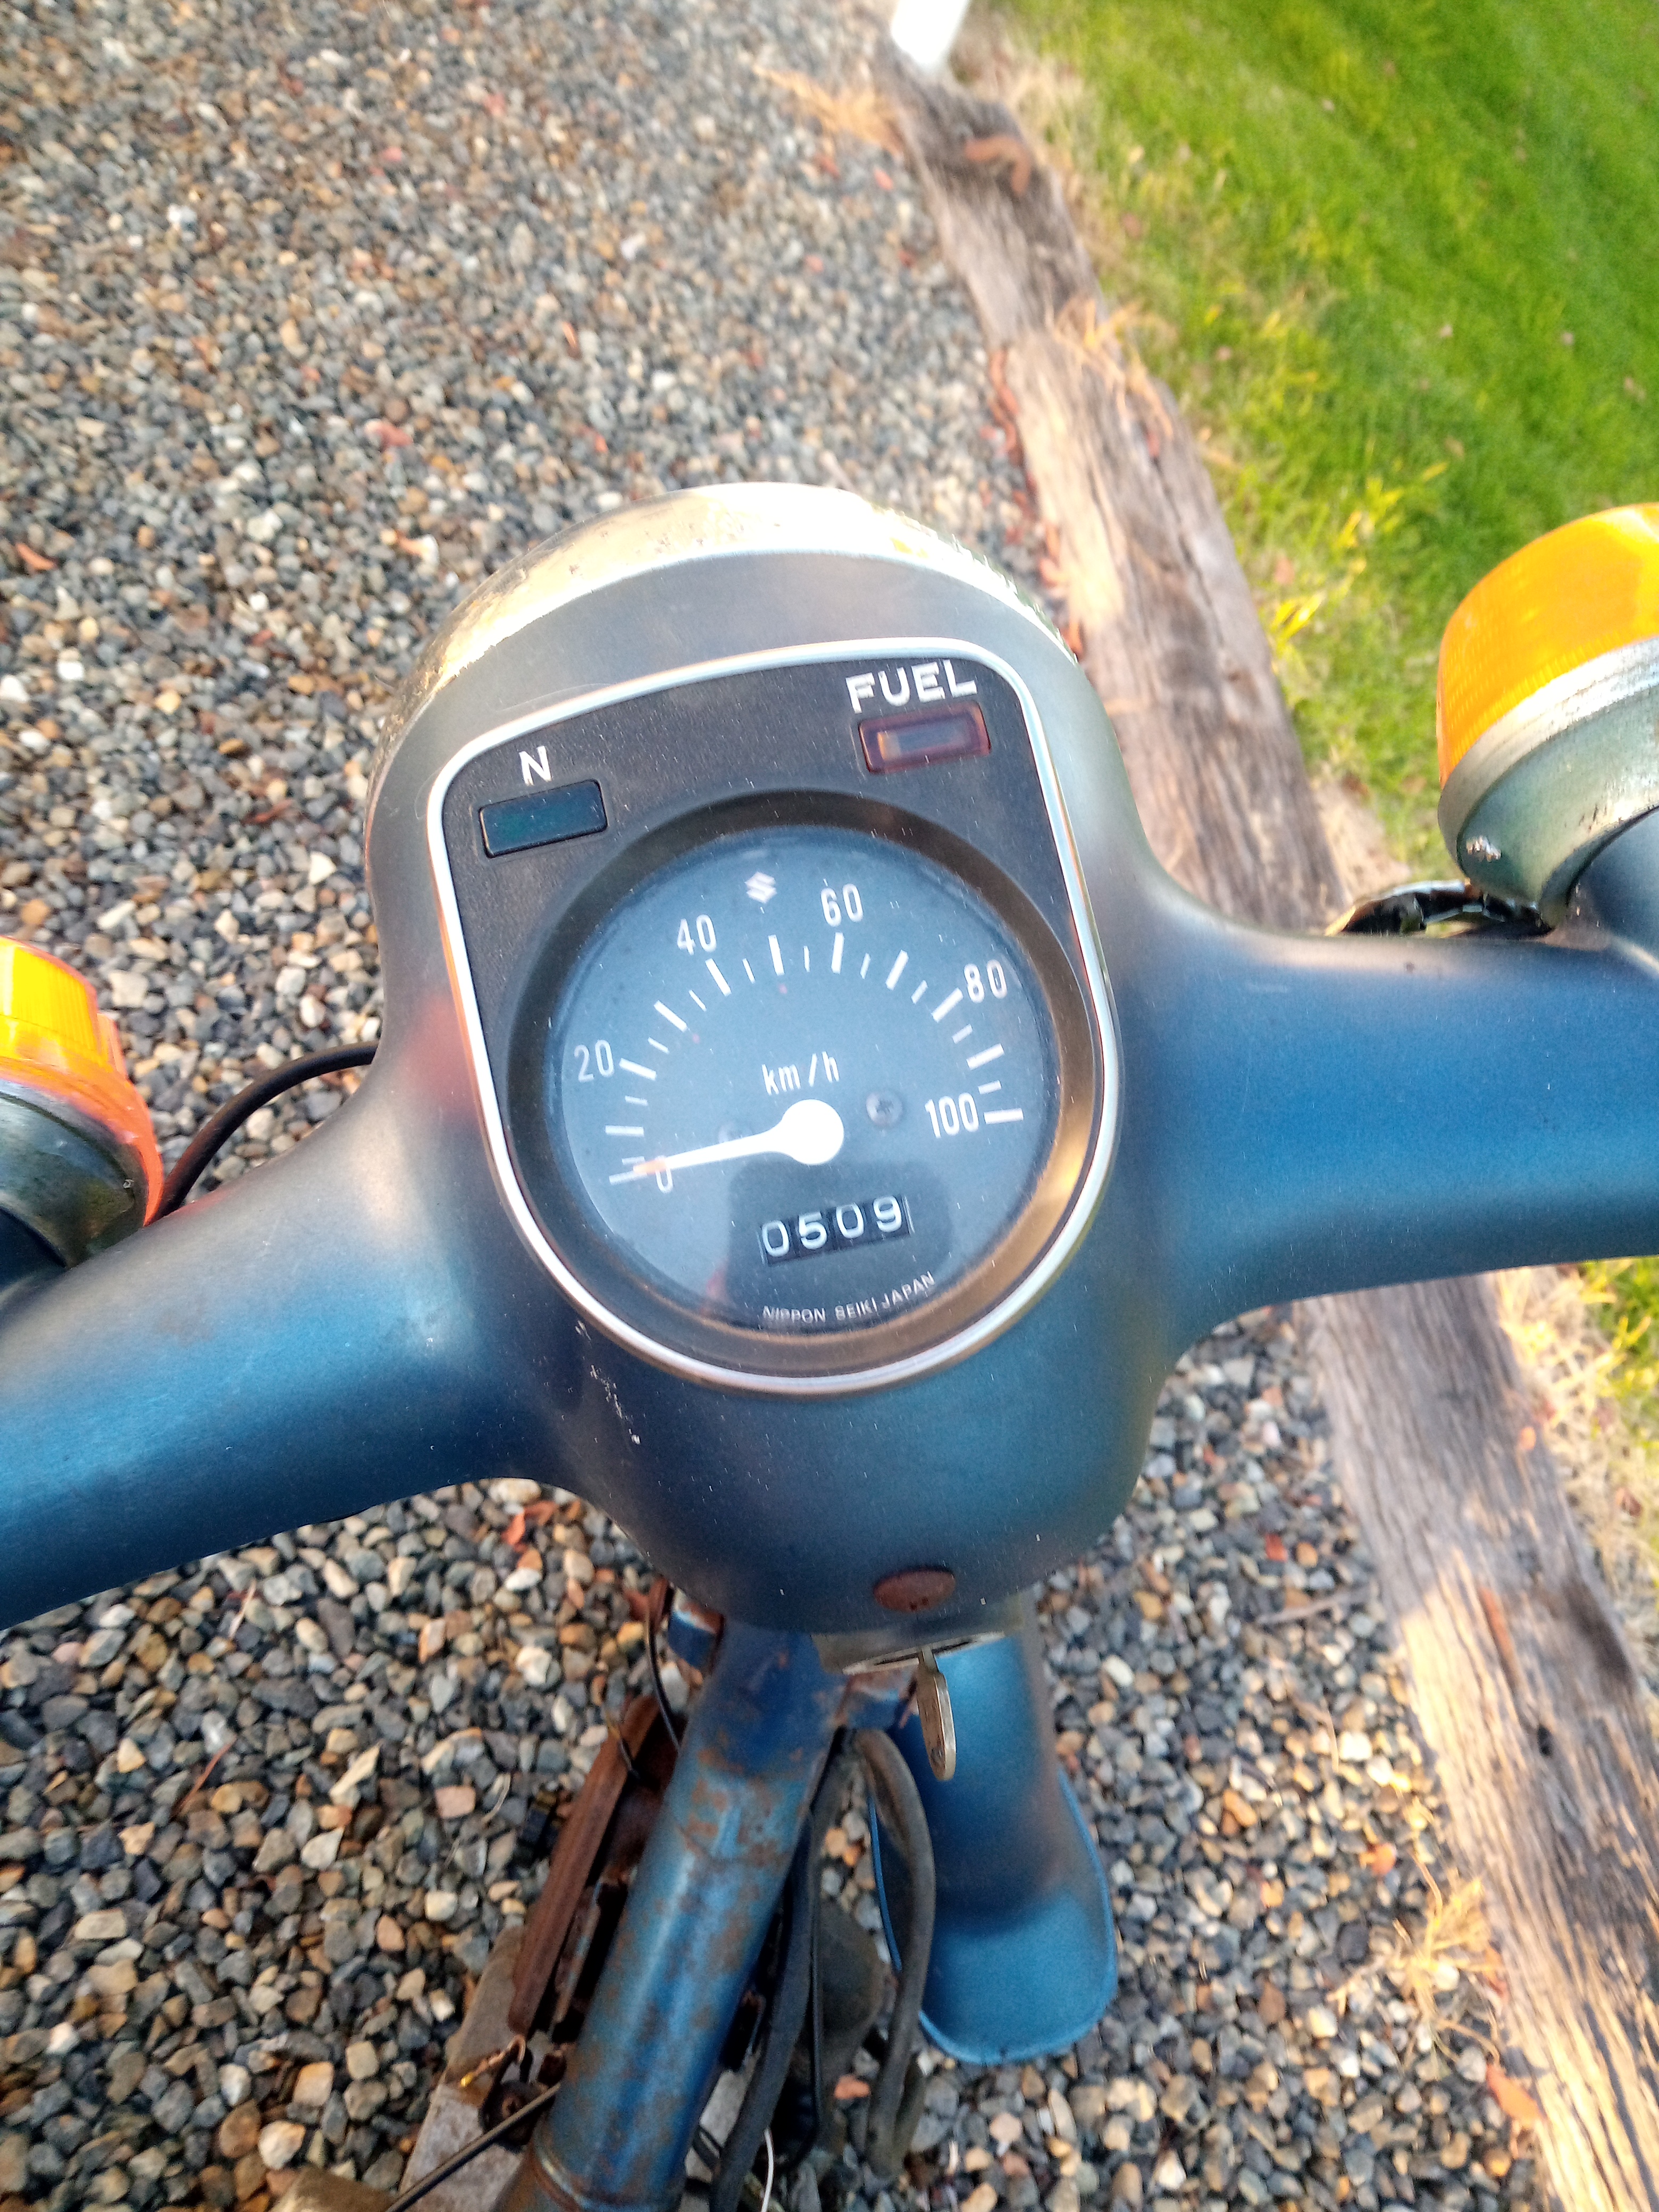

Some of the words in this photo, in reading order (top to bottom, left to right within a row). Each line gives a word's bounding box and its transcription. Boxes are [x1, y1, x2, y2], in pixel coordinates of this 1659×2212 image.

[845, 659, 979, 714] FUEL
[518, 745, 552, 786] N
[820, 883, 865, 927] 60
[676, 914, 717, 955] 40
[963, 959, 1007, 1003] 80
[574, 1040, 614, 1083] 20
[761, 1051, 841, 1096] km/h
[924, 1091, 979, 1138] 100
[761, 1195, 903, 1258] 0509
[762, 1305, 827, 1324] NIPPON
[881, 1270, 936, 1310] JAPAN
